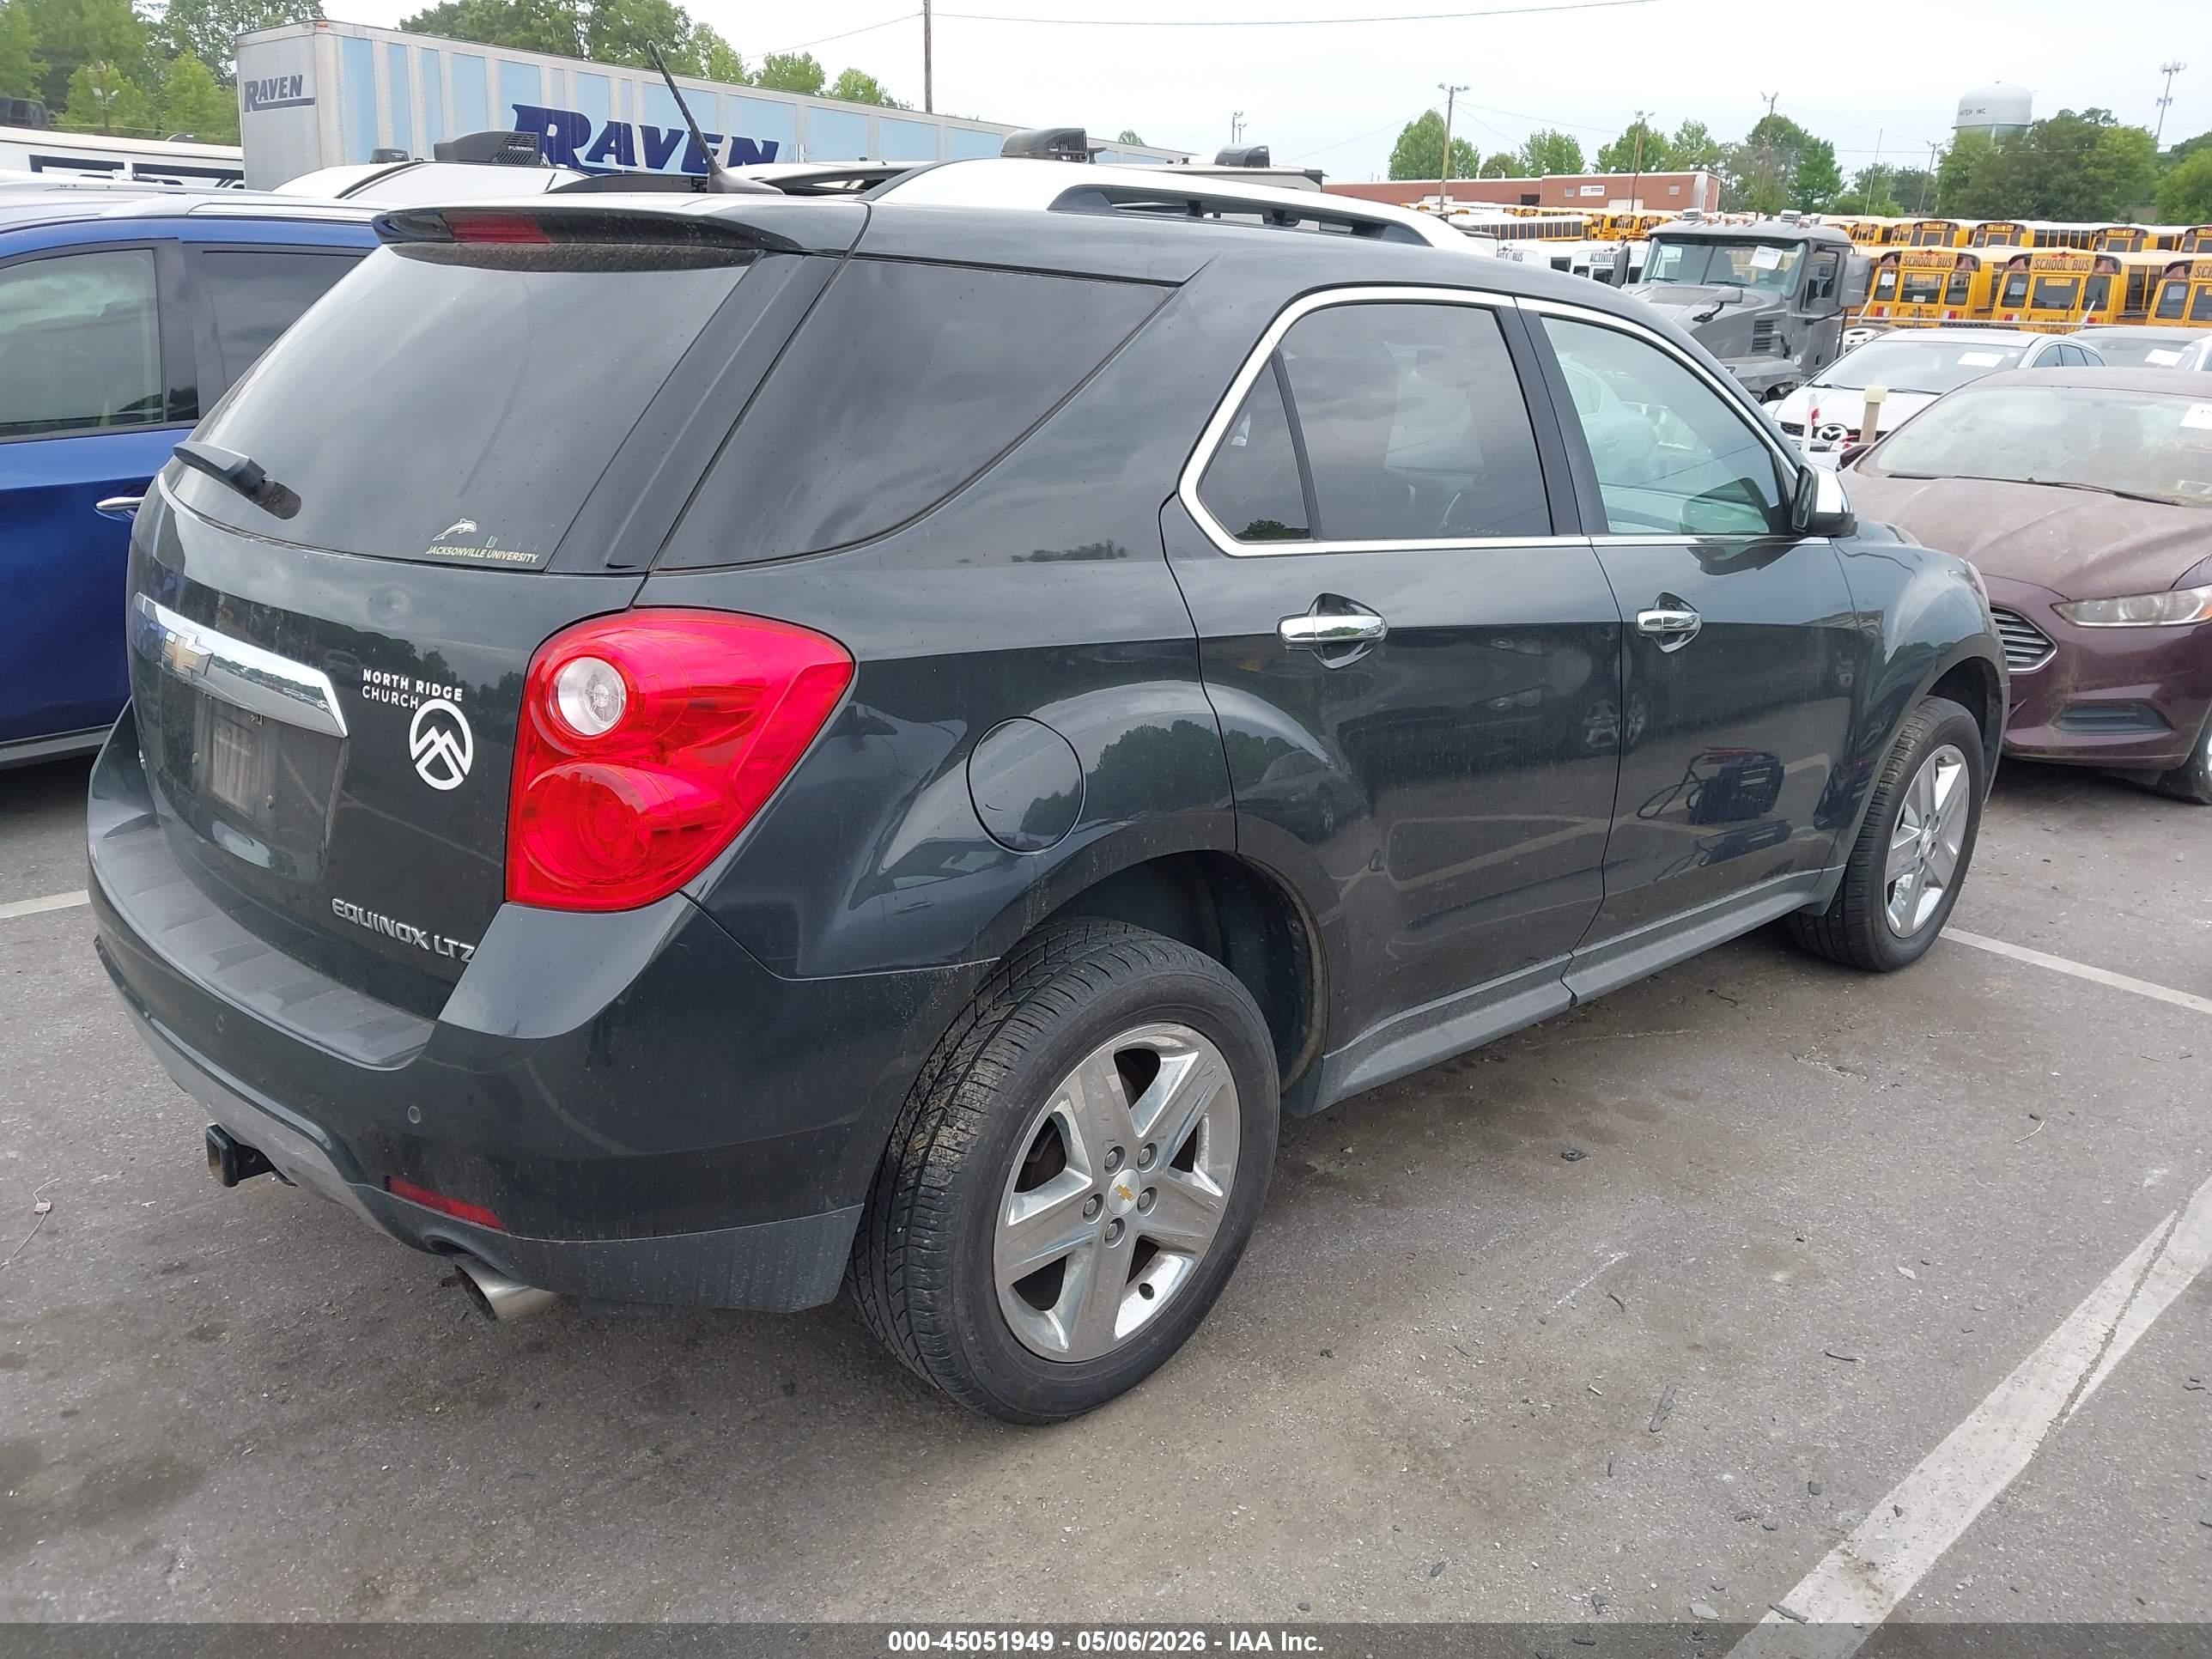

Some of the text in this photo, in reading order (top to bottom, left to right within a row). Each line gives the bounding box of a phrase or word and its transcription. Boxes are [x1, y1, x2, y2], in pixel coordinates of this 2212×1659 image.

[243, 74, 303, 113] RAVEN
[512, 103, 780, 175] RAVEN
[1902, 255, 1953, 269] SCHOOL BUS
[2033, 258, 2090, 271] SCHOOL BUS
[426, 544, 539, 563] JACKSONVILLE UNIVERSITY
[362, 668, 463, 702] NORTH RIDGE
[362, 685, 419, 709] CHURCH
[331, 897, 475, 963] EQUINOX LTZ
